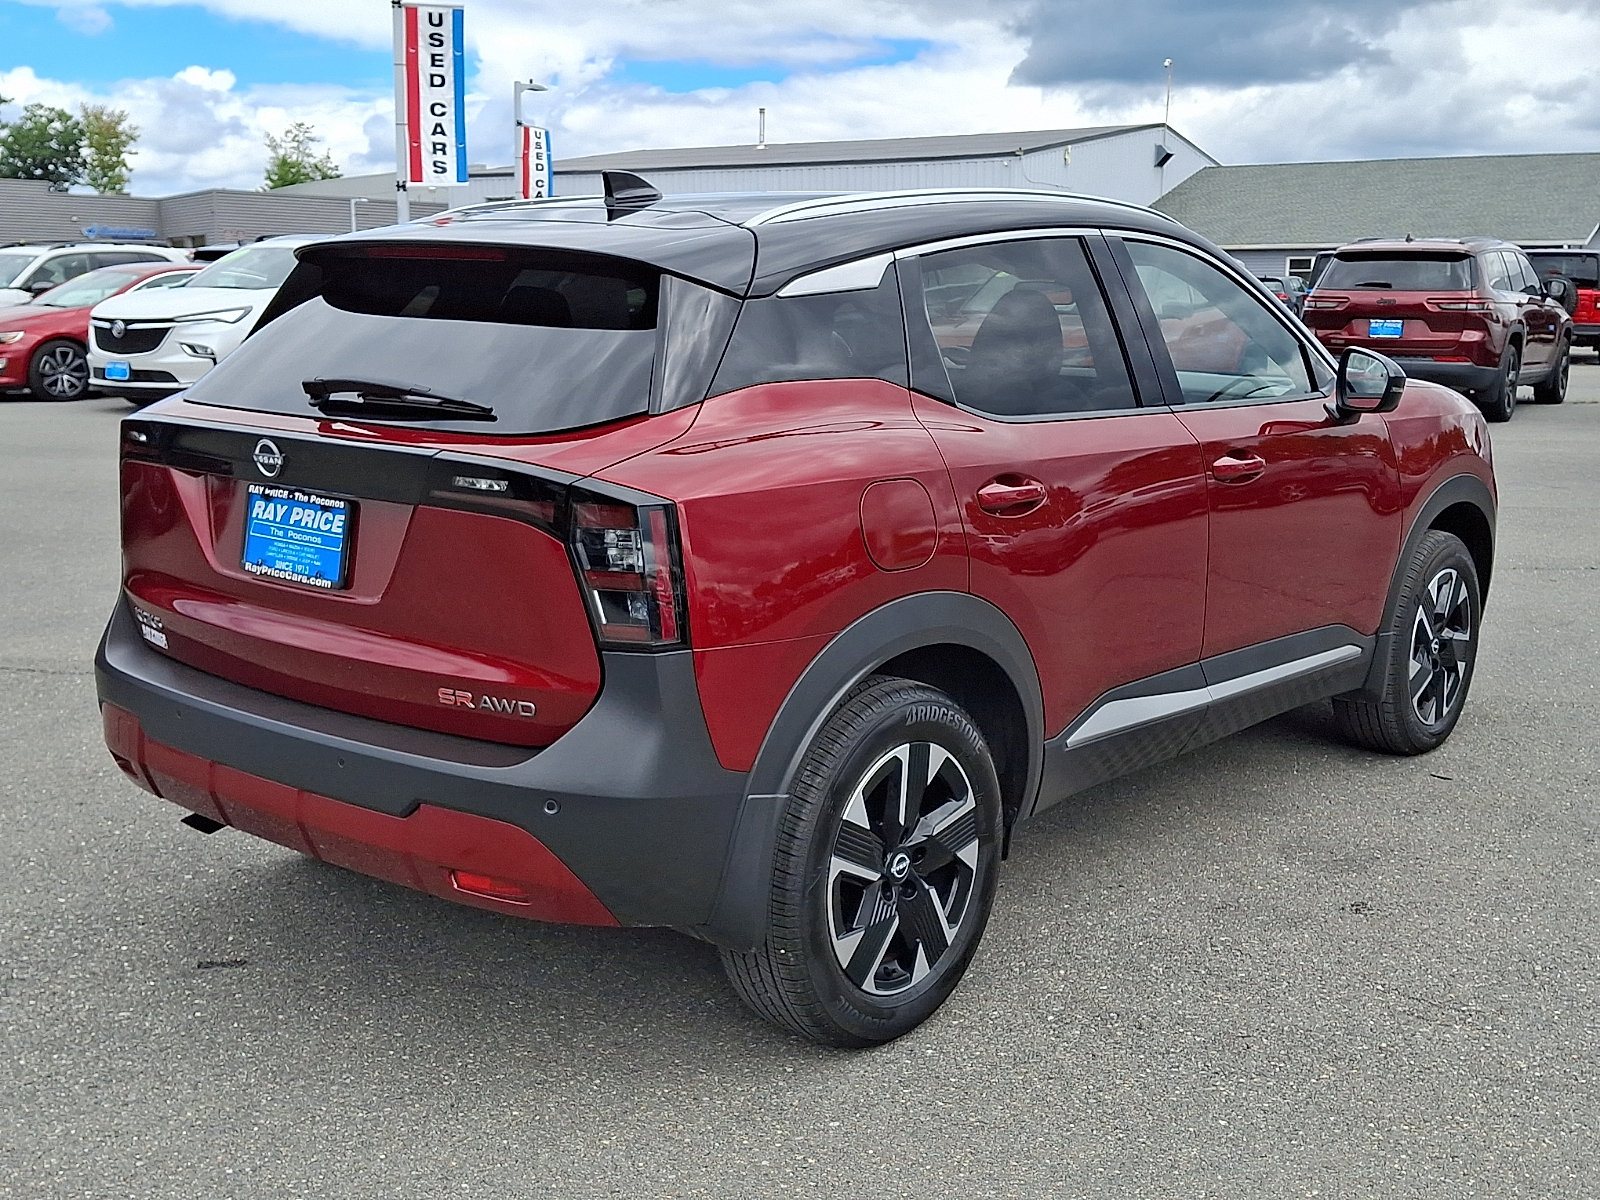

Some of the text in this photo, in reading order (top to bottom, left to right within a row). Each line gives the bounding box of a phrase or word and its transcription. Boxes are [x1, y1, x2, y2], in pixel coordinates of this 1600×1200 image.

[428, 12, 448, 174] USED CARS
[534, 131, 545, 199] USED CA
[248, 484, 264, 495] RAY
[294, 492, 308, 503] The
[310, 495, 345, 508] Poconos
[252, 500, 346, 533] RAY PRICE
[270, 527, 322, 544] The Poconos
[244, 562, 332, 588] RayPriceCars.com
[274, 560, 293, 571] SINCE
[438, 687, 536, 717] SR AWD
[905, 705, 984, 755] BRIDGESTONE
